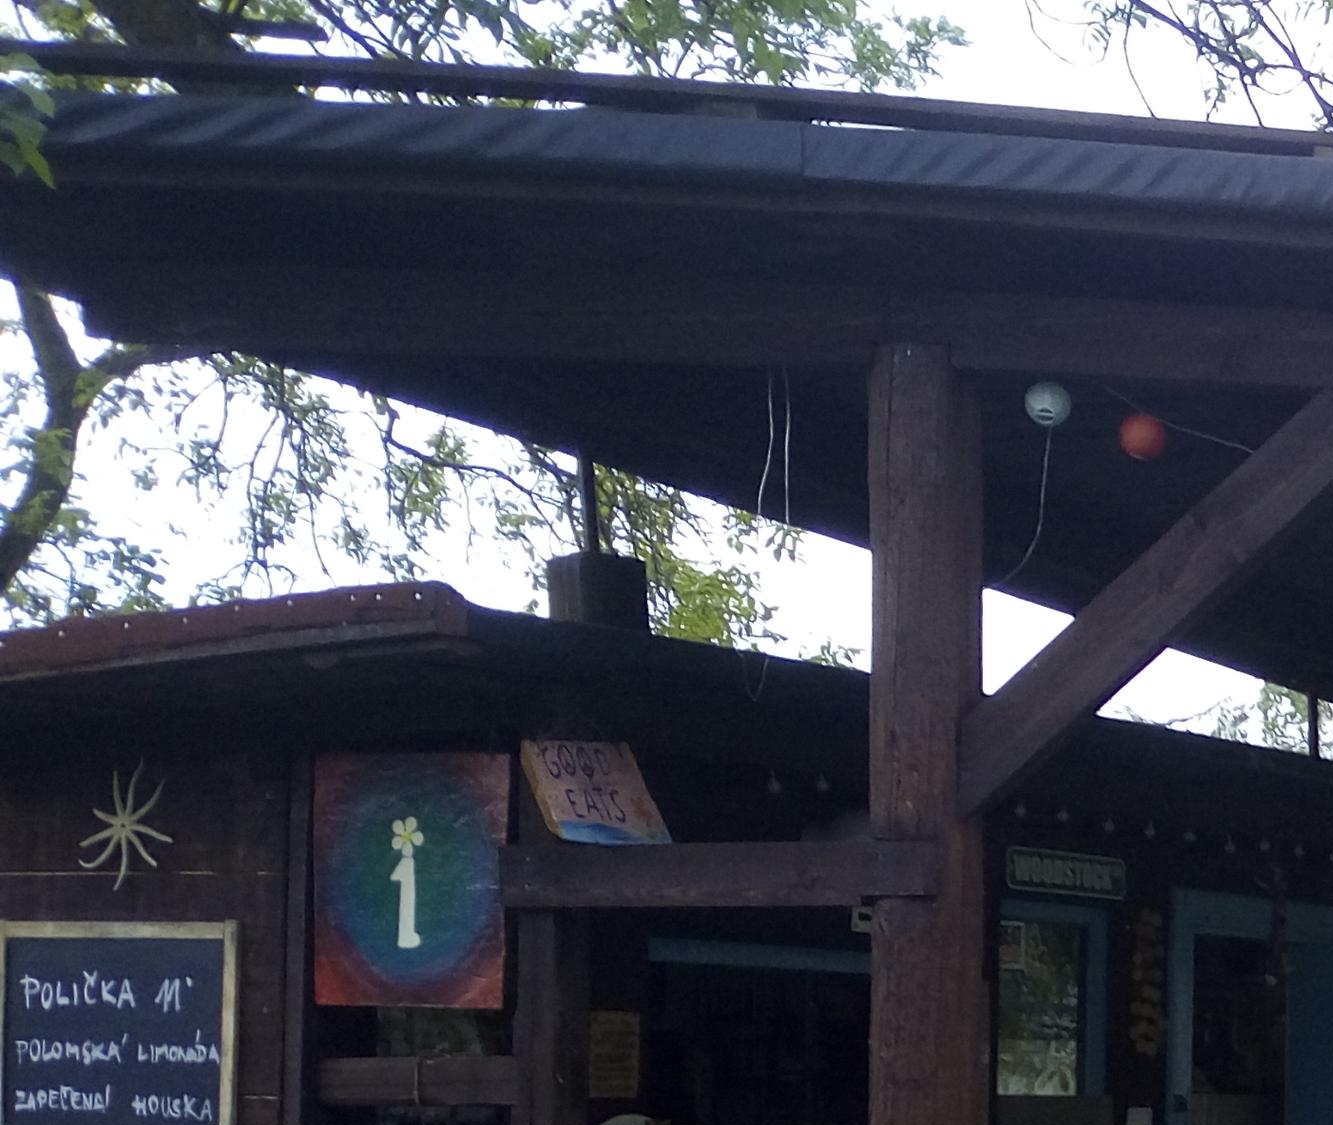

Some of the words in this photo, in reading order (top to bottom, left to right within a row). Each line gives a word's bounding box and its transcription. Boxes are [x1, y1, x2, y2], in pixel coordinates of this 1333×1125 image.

[541, 744, 610, 779] GOOD
[565, 788, 627, 824] EATS
[19, 970, 136, 1010] POLIČKA
[15, 1032, 129, 1065] POLOMSKÁ
[131, 1093, 213, 1122] HOUSKA
